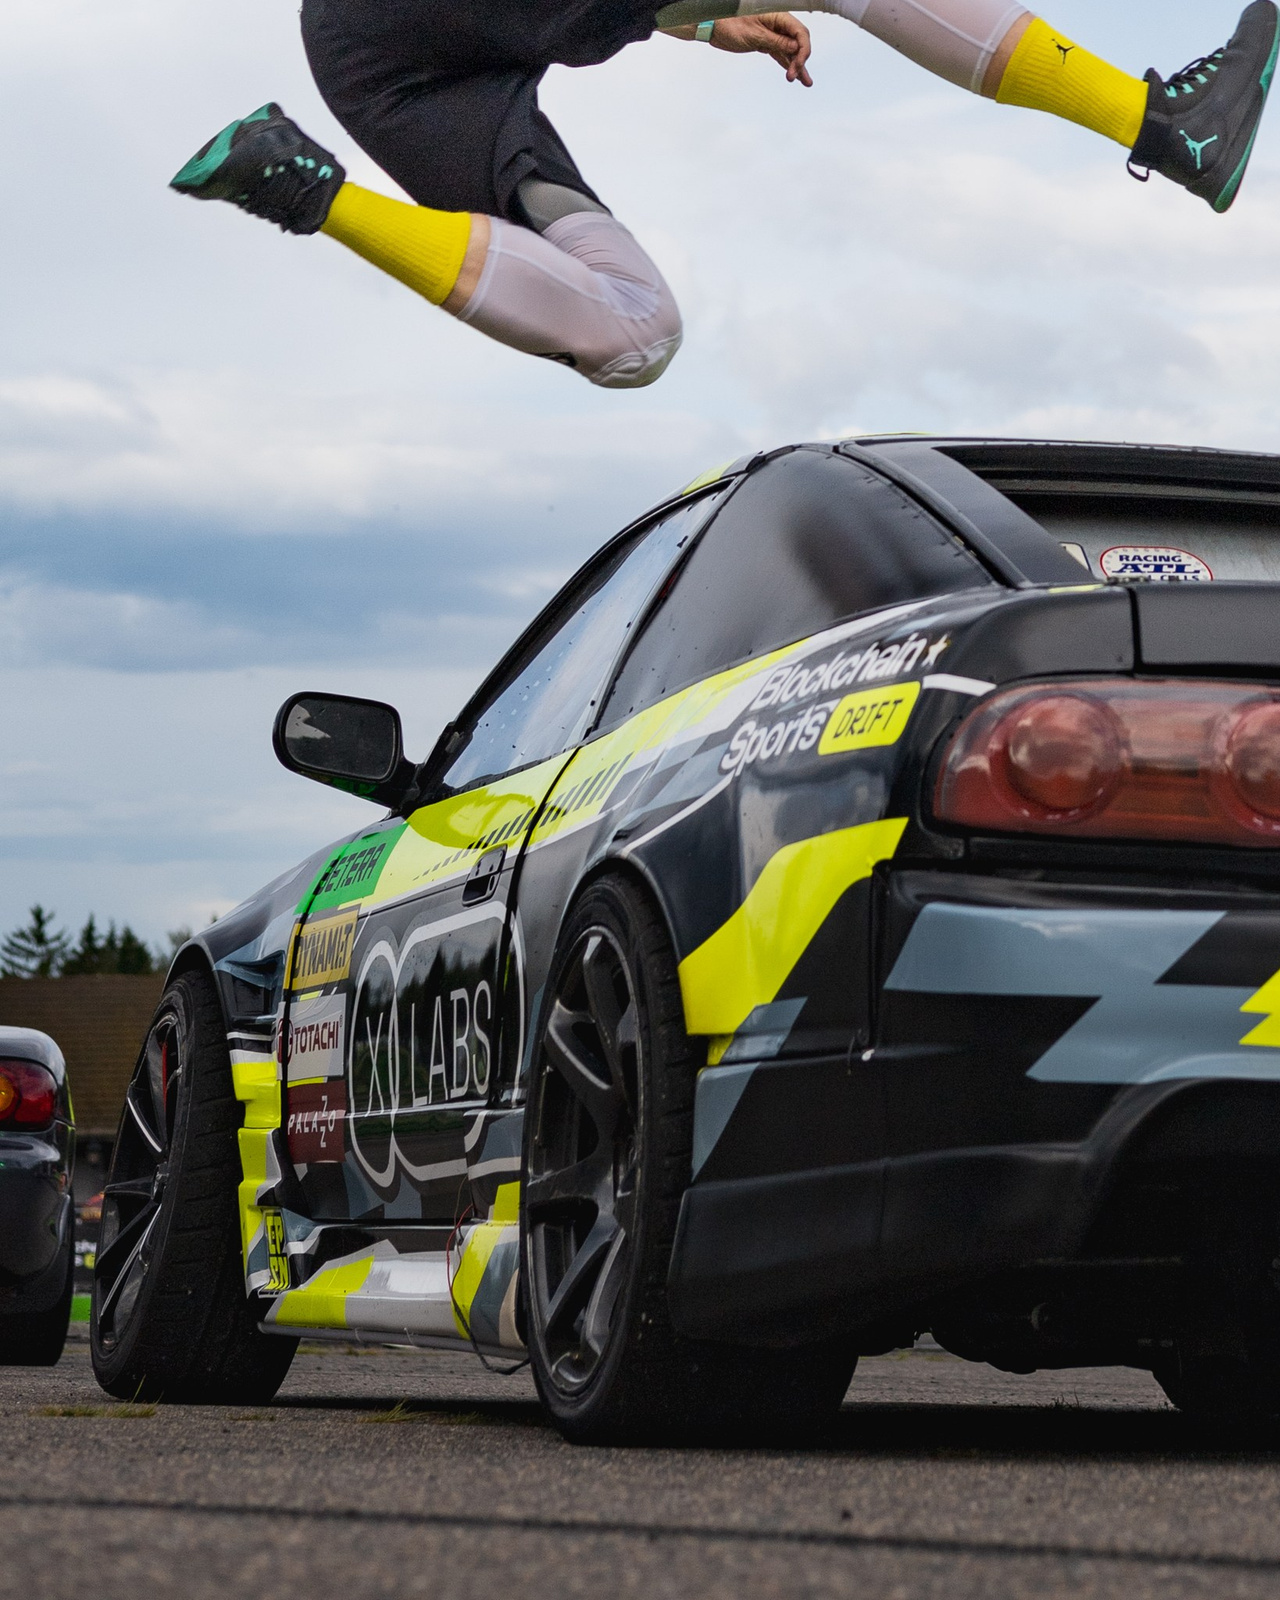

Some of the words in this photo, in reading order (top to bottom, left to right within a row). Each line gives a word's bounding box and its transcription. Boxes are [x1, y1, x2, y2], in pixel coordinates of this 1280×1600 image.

[1111, 562, 1200, 574] ATL
[1118, 554, 1182, 563] RACING
[749, 632, 928, 712] Blockchain
[720, 708, 827, 777] Sports
[833, 698, 904, 739] DRIFT
[294, 1020, 339, 1055] TOTACHI
[411, 979, 492, 1108] LABS
